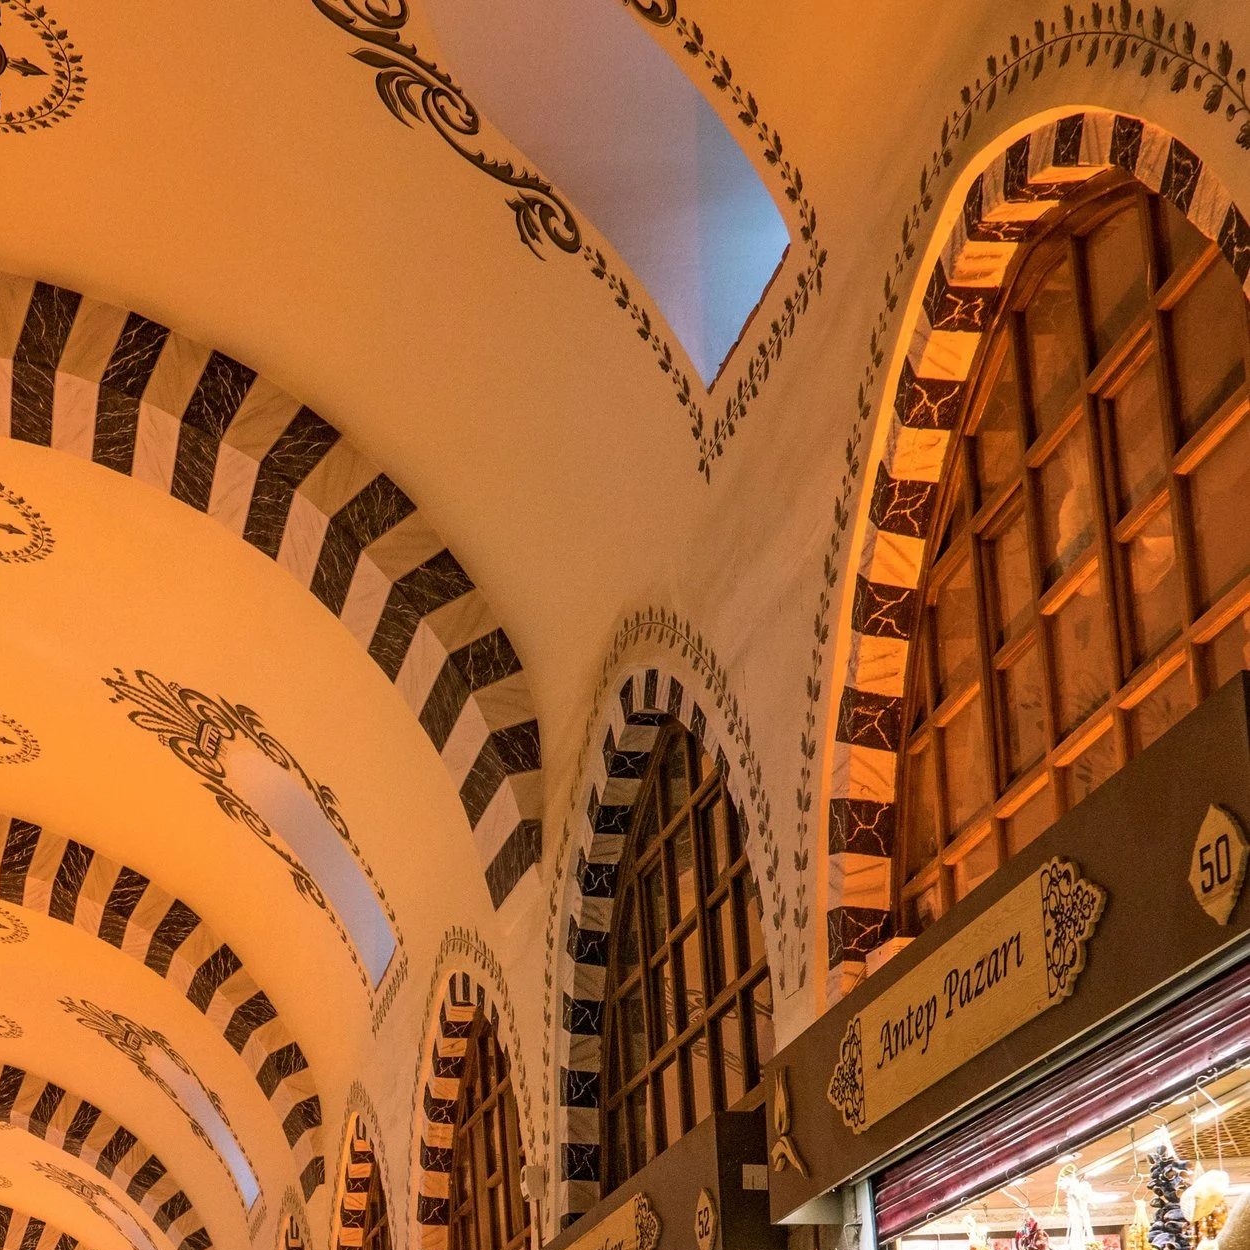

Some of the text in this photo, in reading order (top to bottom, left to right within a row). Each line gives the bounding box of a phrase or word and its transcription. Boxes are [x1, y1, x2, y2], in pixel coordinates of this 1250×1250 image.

[1199, 834, 1231, 894] 50
[876, 930, 1025, 1070] Antep Pazarı
[697, 1206, 710, 1240] 52
